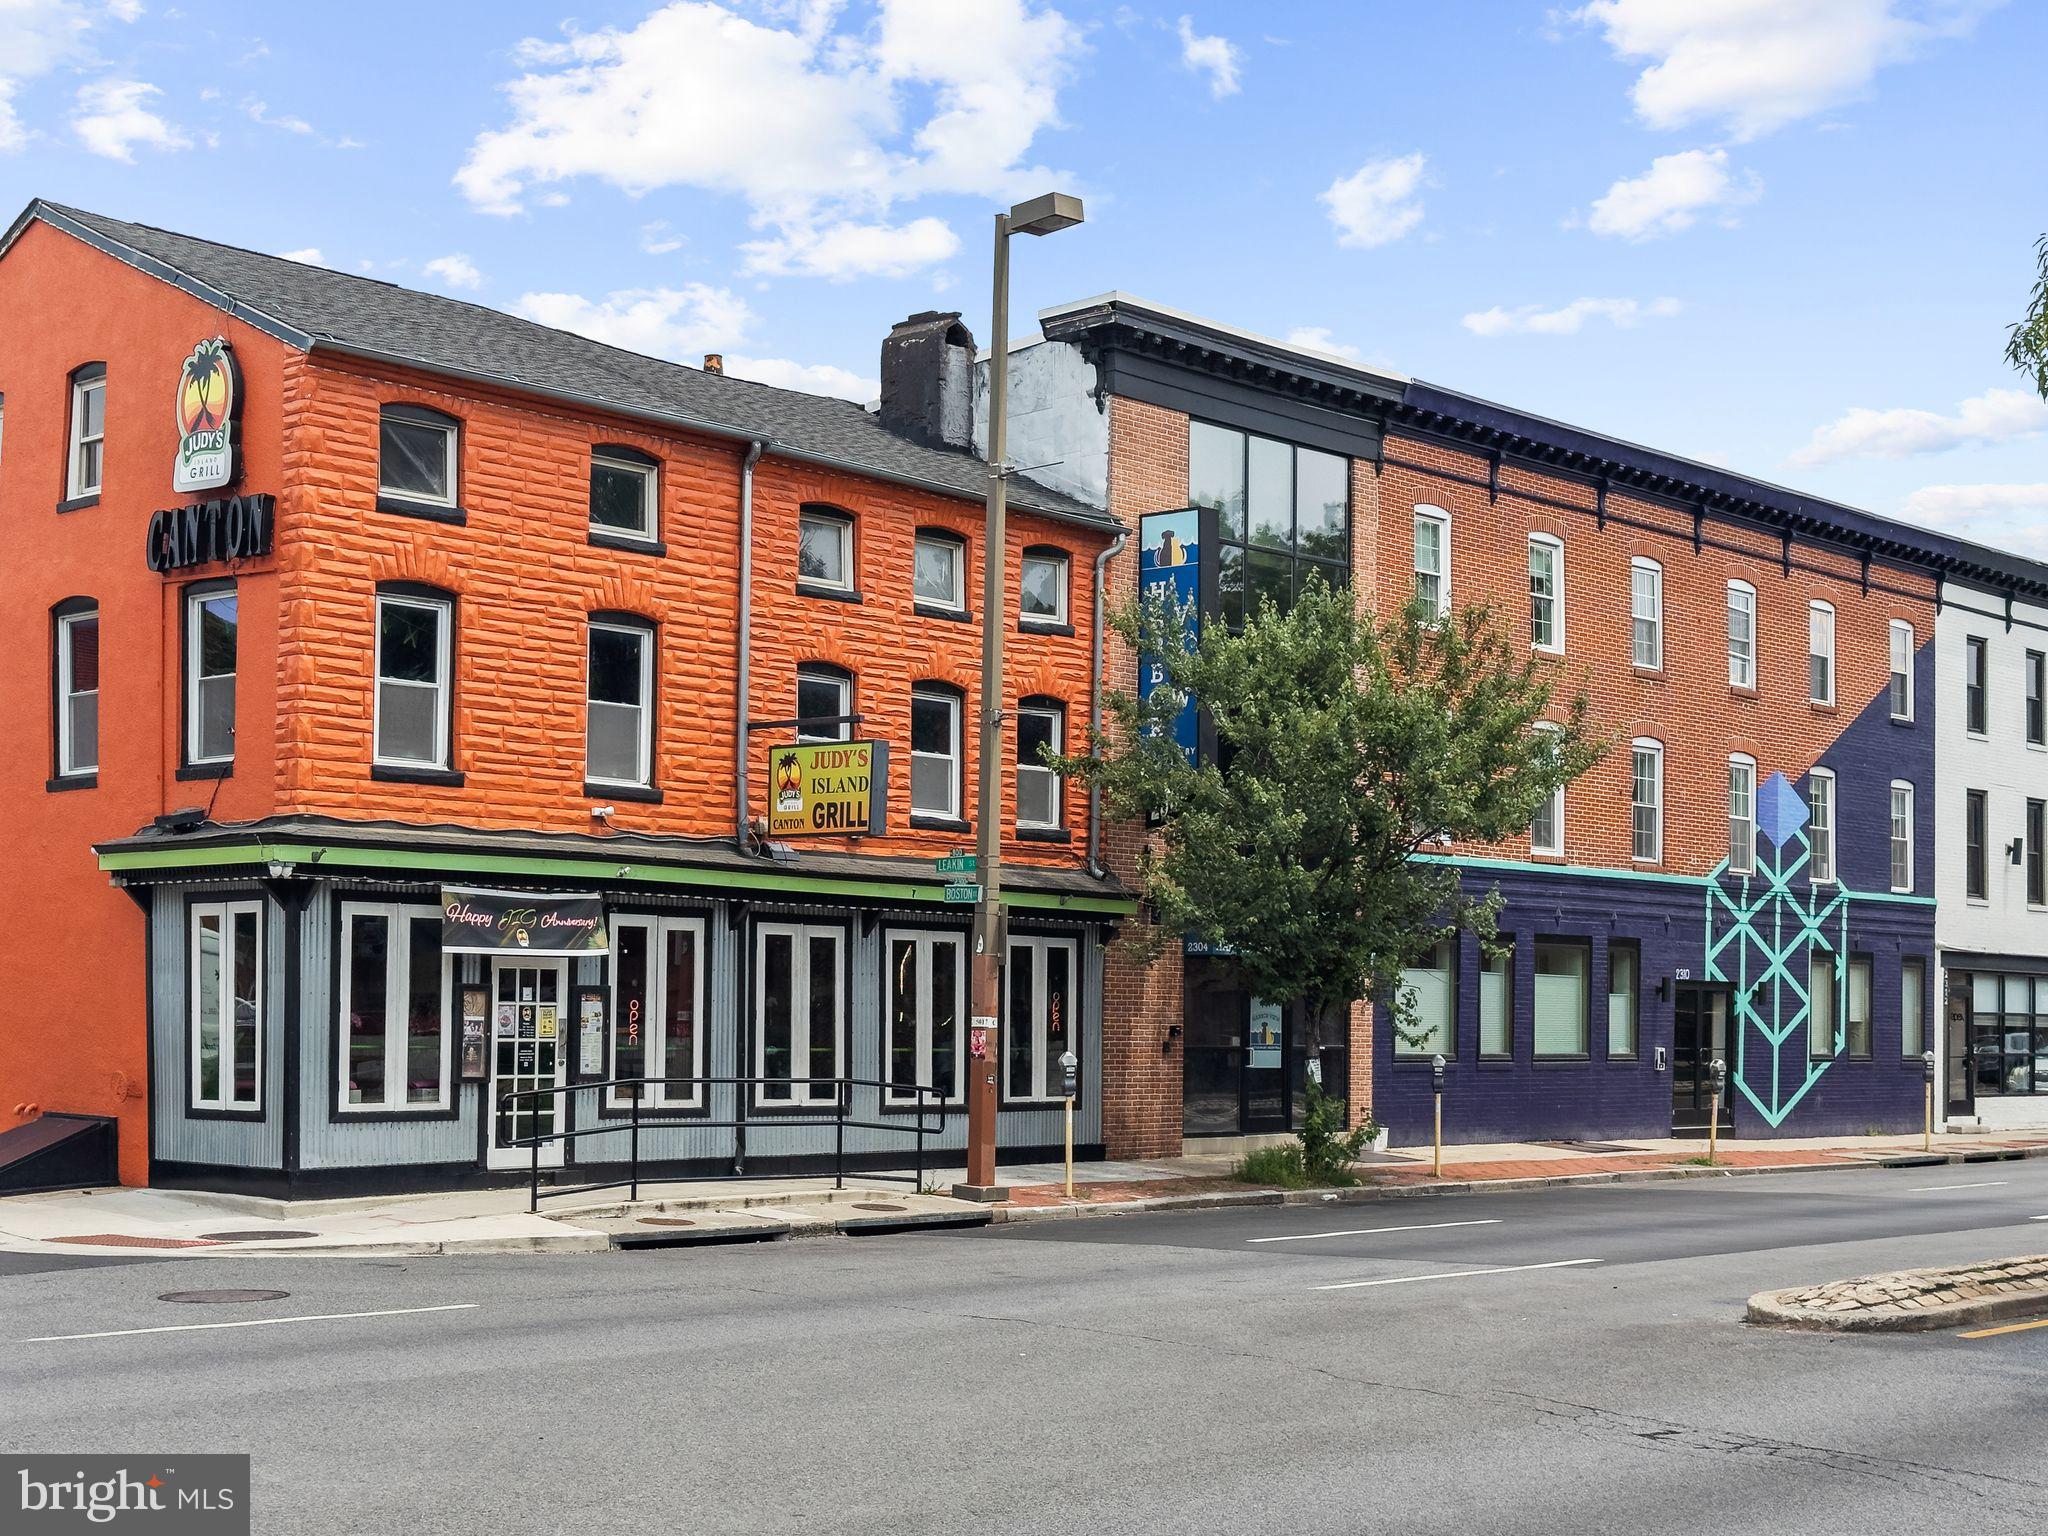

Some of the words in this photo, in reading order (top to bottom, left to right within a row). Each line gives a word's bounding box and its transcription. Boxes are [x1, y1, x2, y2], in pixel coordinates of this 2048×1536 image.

[185, 430, 224, 456] JUDY'S
[190, 465, 220, 479] GRILL
[147, 494, 265, 571] CANTON
[810, 749, 869, 770] JUDY'S
[811, 775, 869, 795] ISLAND
[780, 790, 801, 800] JUDY'S
[812, 801, 868, 829] GRILL
[773, 818, 805, 830] CANTON
[938, 858, 964, 871] LEAKIN
[946, 888, 973, 900] BOSTON
[446, 902, 493, 928] Happy
[540, 911, 598, 930] Anniversary!
[1187, 942, 1208, 952] 2304
